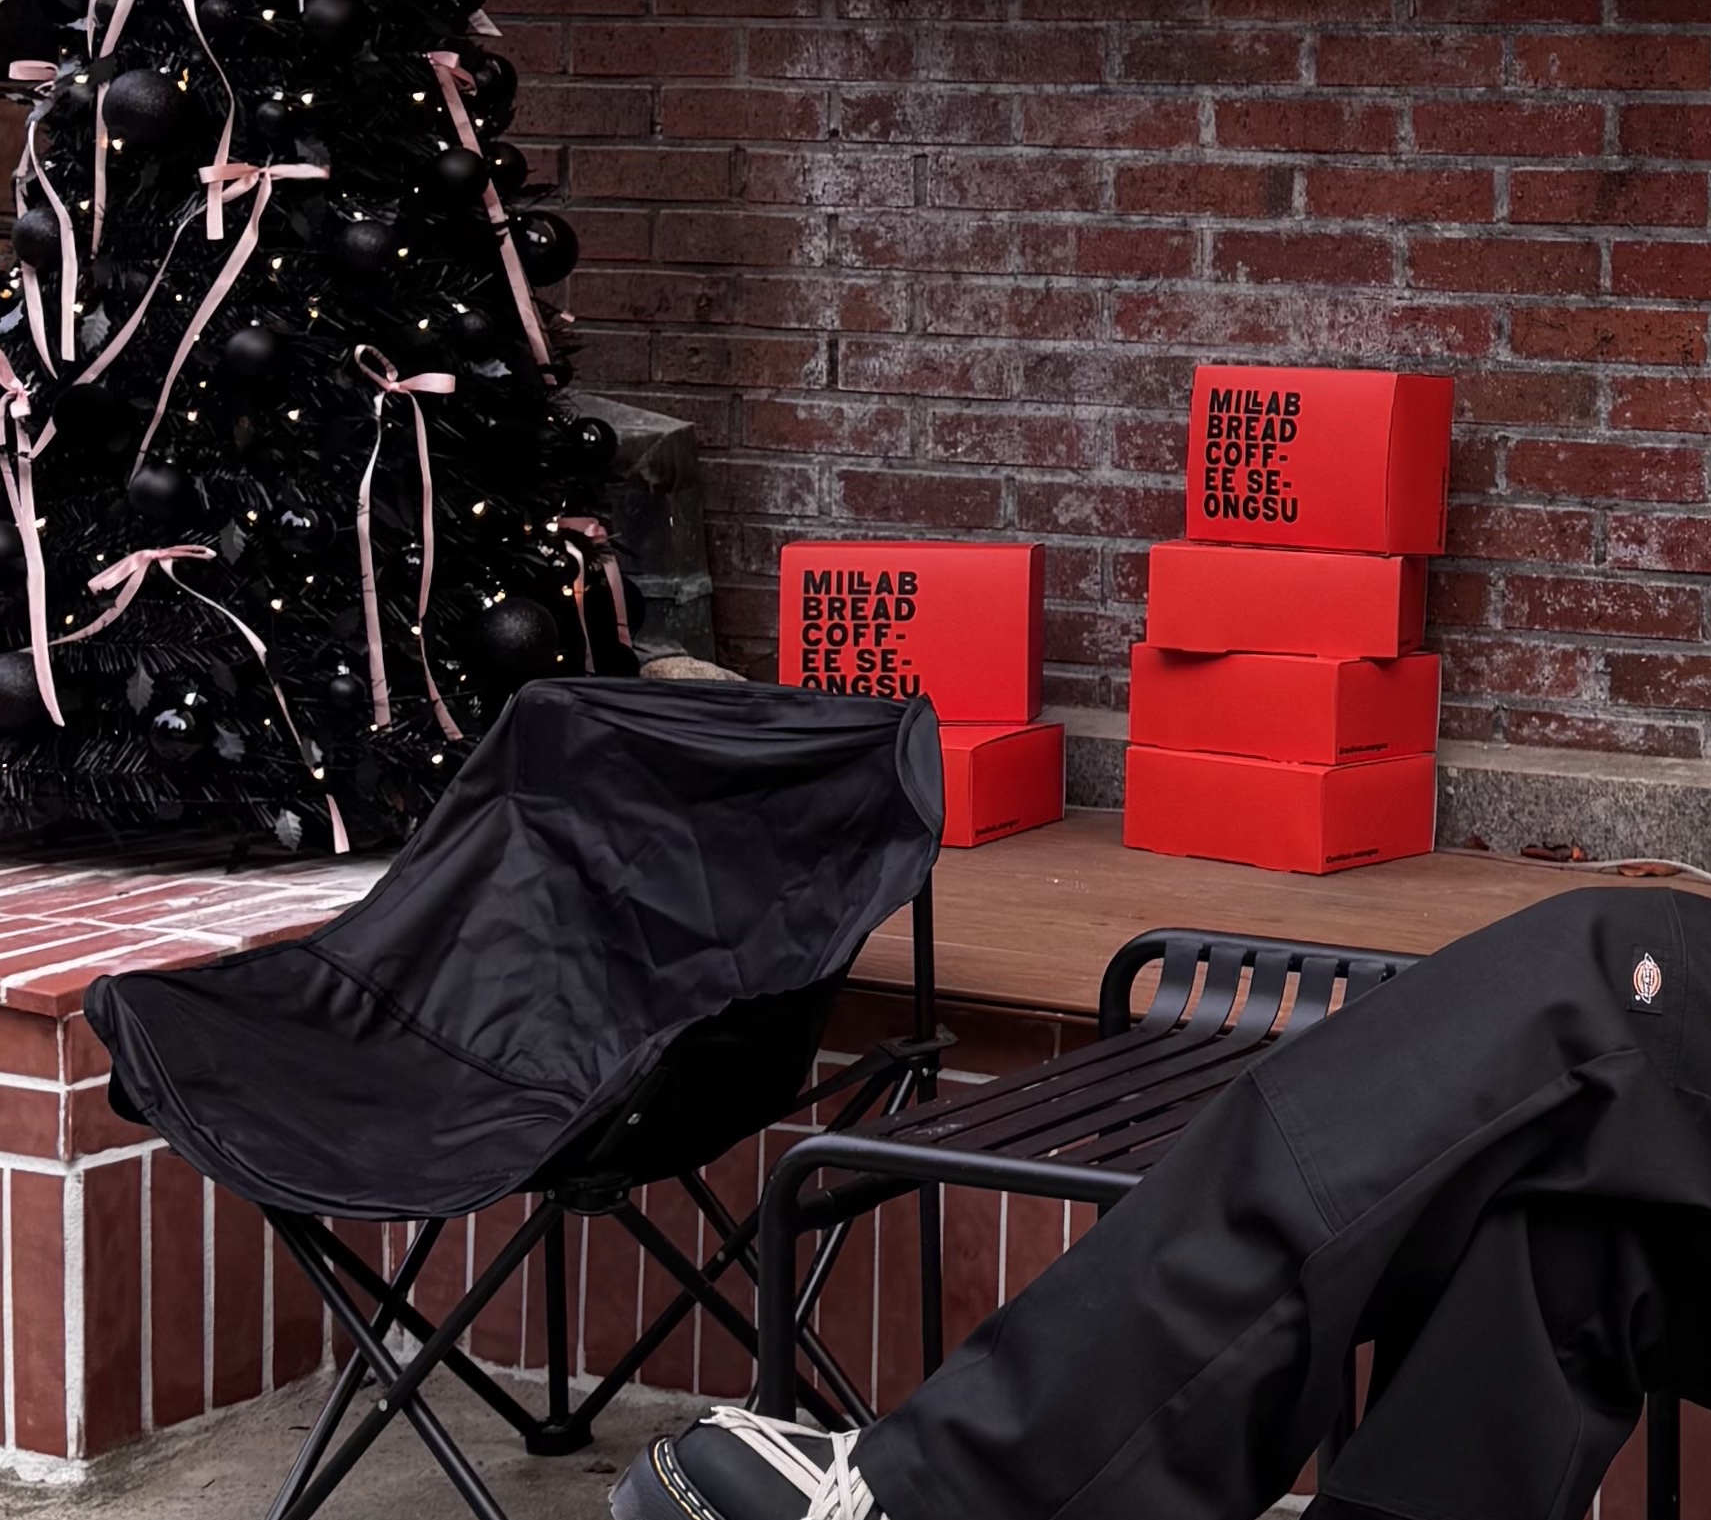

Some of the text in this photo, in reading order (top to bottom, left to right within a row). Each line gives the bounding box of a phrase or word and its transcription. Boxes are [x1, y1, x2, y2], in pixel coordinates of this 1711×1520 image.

[1208, 388, 1301, 416] MILLAB
[1206, 414, 1298, 443] BREAD
[1205, 440, 1288, 468] COFF-
[1204, 466, 1292, 496] EE SE-
[1203, 492, 1298, 524] ONGSU
[803, 570, 918, 596] MILLAB
[802, 596, 916, 621] BREAD
[801, 622, 906, 647] COFF-
[801, 648, 912, 673] EE SE-
